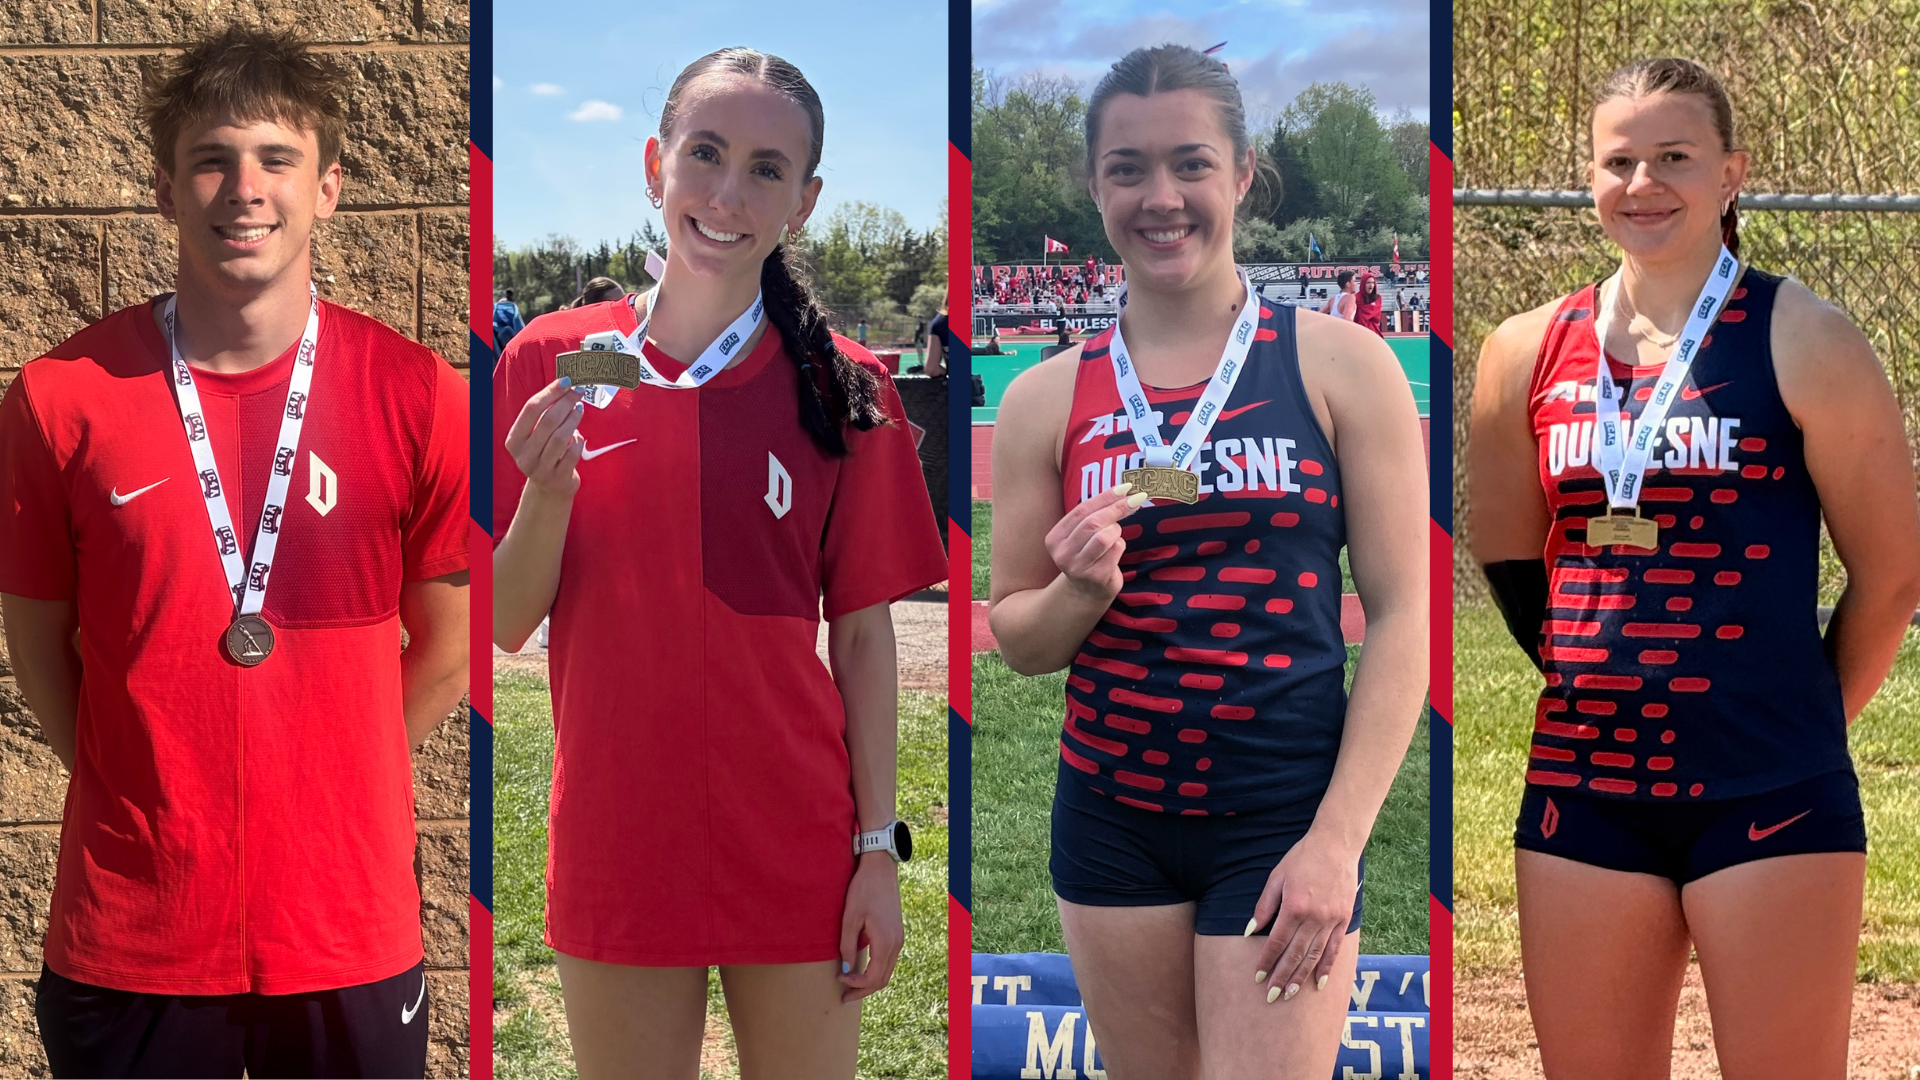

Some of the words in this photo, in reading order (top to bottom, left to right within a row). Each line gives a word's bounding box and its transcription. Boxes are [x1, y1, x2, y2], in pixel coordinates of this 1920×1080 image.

[1698, 295, 1717, 319] ECAC
[719, 332, 740, 355] ECAC
[1236, 321, 1252, 345] ECAC
[1677, 339, 1695, 362] ECAC
[558, 351, 638, 383] ECAC
[1221, 359, 1236, 384] ECAC
[287, 391, 303, 419] IC4A
[1656, 382, 1674, 405] ECAC
[1129, 394, 1146, 419] ECAC
[1197, 401, 1216, 426] ECAC
[189, 412, 205, 441] IC4A
[1604, 421, 1616, 446] ECAC
[1636, 426, 1652, 450] ECAC
[275, 447, 291, 475] IC4A
[204, 469, 220, 498] IC4A
[1123, 469, 1198, 499] ECAC
[1622, 473, 1637, 499] ECAC
[262, 504, 278, 533] IC4A
[219, 526, 236, 555] IC4A
[250, 562, 266, 591] IC4A
